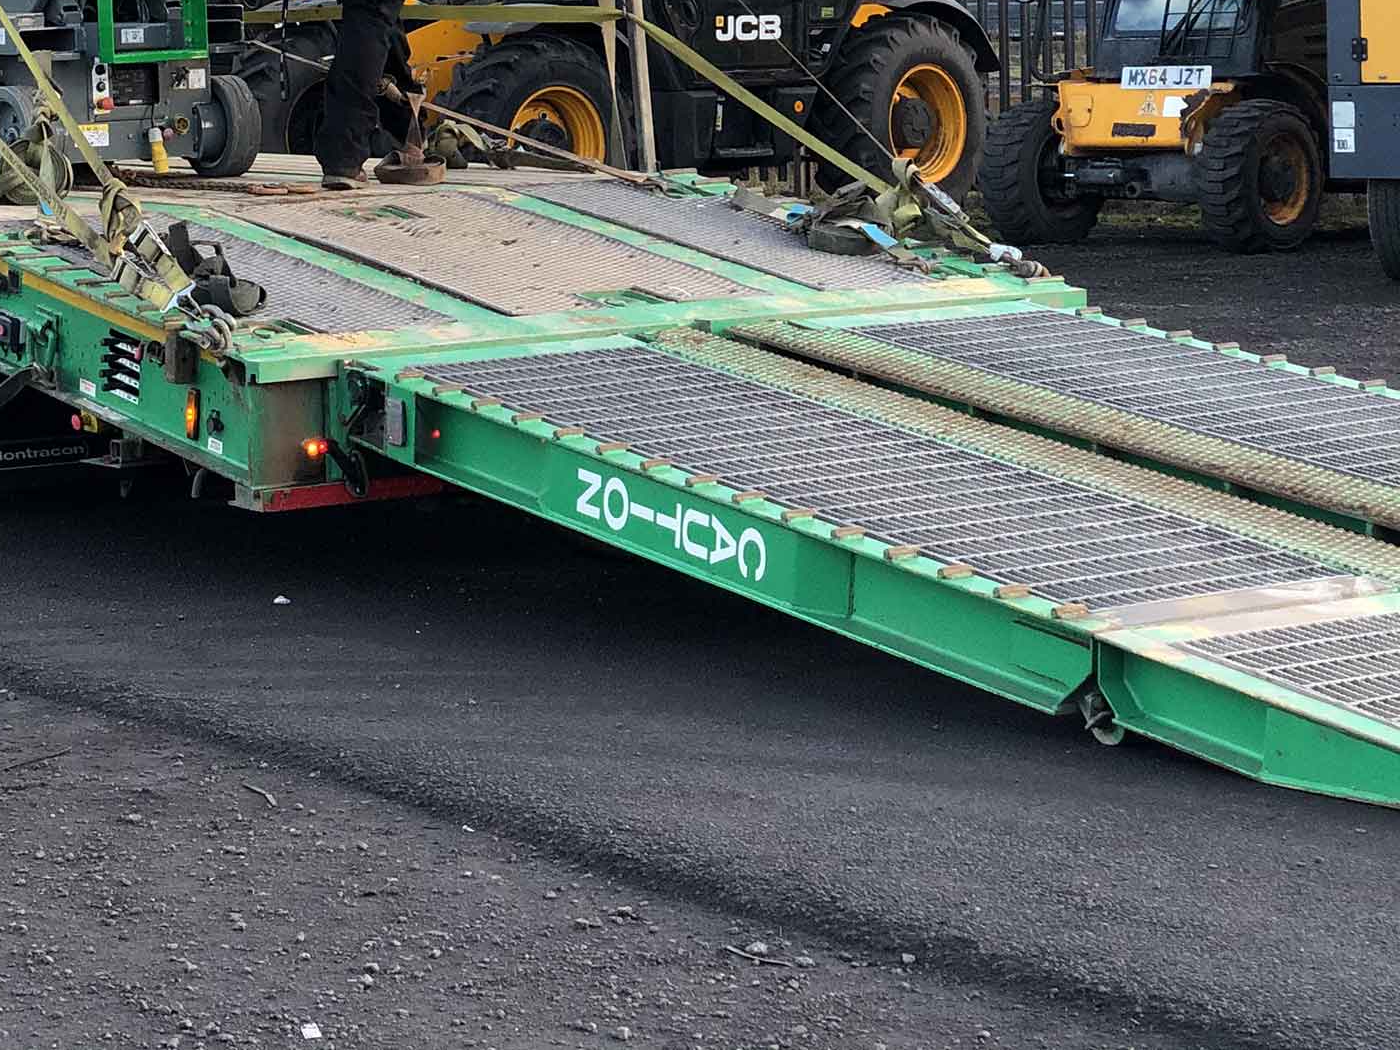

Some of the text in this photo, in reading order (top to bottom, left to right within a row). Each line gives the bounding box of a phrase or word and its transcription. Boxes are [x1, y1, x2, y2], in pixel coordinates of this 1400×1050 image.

[715, 15, 782, 41] JCB
[1127, 68, 1205, 86] MX64 JZT
[576, 468, 767, 582] CAUTION
